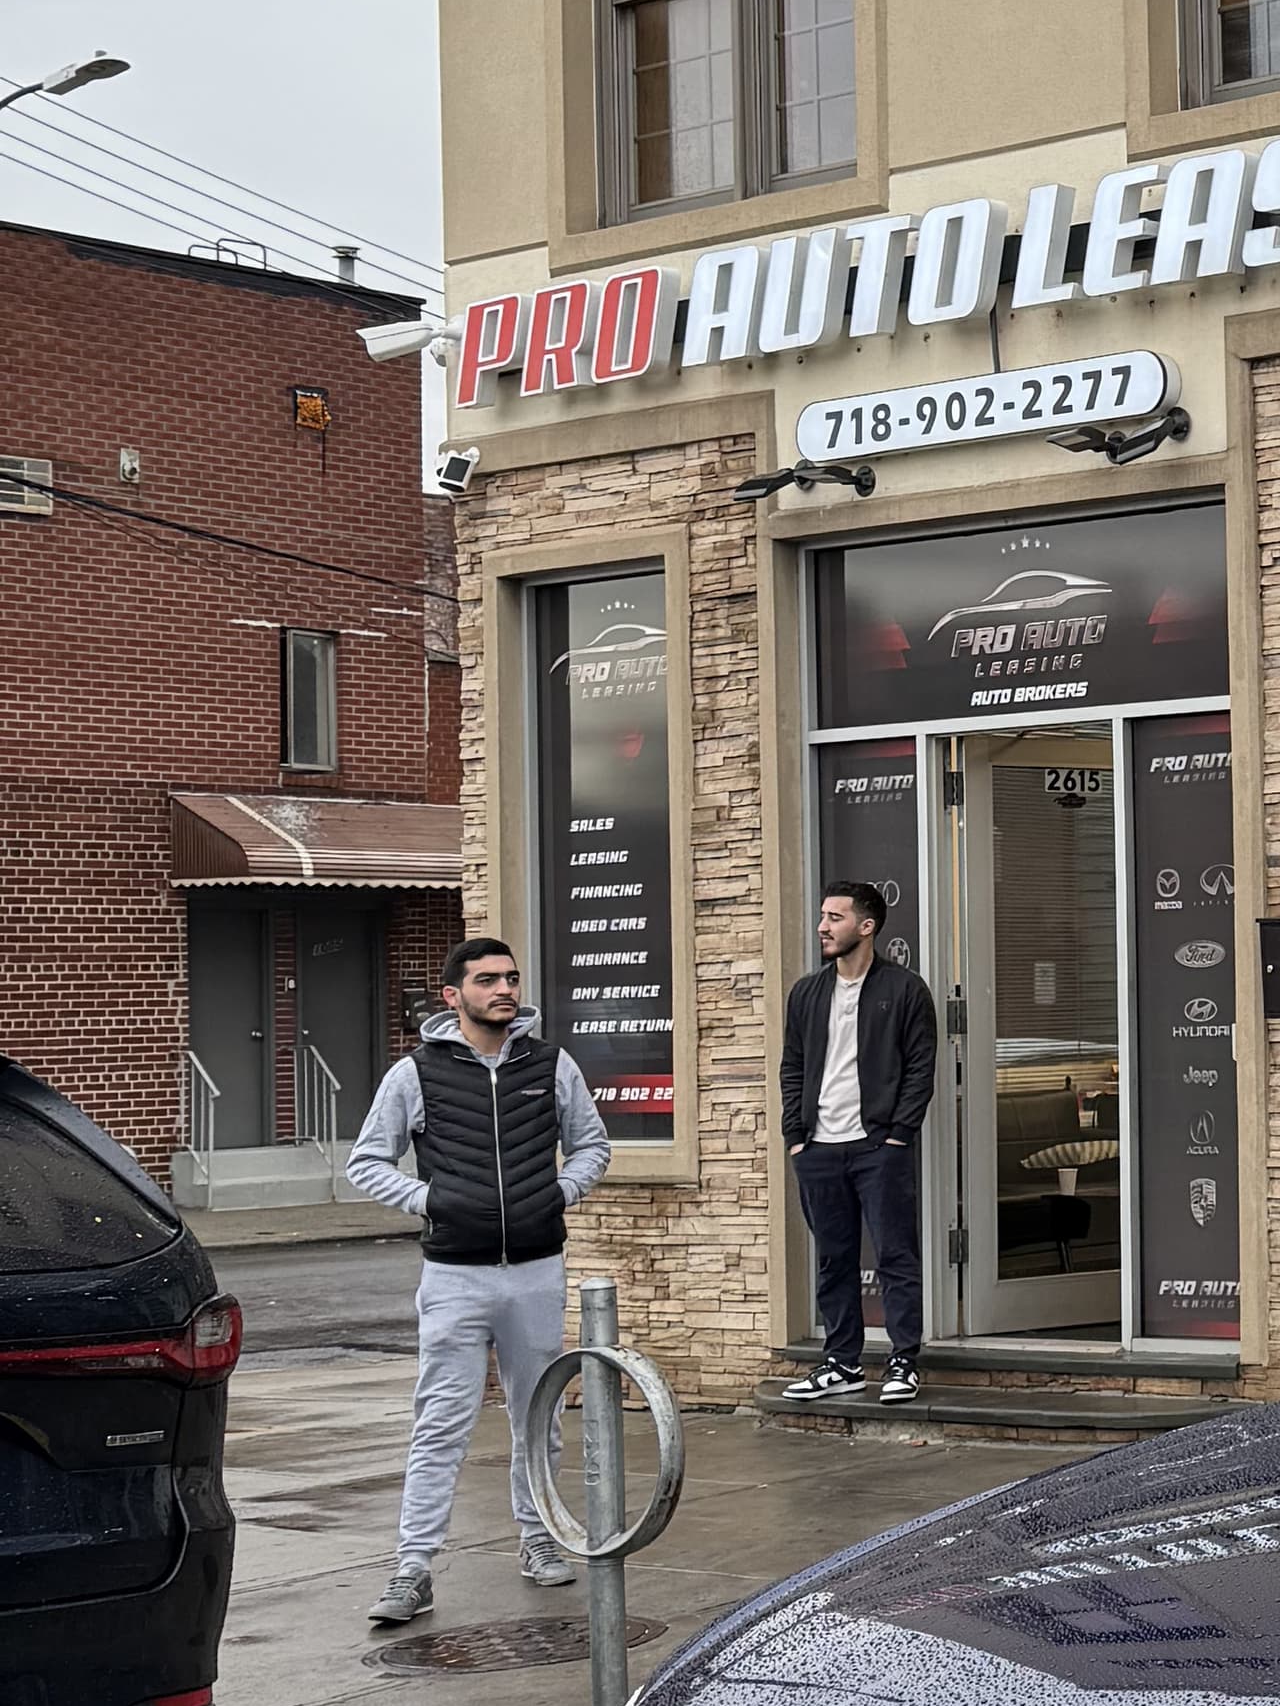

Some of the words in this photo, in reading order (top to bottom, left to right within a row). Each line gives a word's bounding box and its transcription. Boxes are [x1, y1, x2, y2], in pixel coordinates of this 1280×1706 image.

[455, 264, 680, 408] PRO
[681, 198, 1008, 368] AUTO
[824, 365, 1133, 450] 718-902-2277
[951, 620, 1017, 658] PRO
[1019, 614, 1109, 651] AUTO
[565, 661, 611, 685] PRO
[615, 655, 668, 680] AUTO
[974, 652, 1086, 678] LEASING
[581, 681, 657, 699] LEASING
[970, 688, 1011, 707] AUTO
[1014, 681, 1089, 704] BROKERS
[1149, 755, 1188, 773] PRO
[834, 778, 868, 794] PRO
[870, 774, 915, 791] AUTO
[1047, 770, 1101, 792] 2615
[569, 817, 615, 833] SALES
[570, 850, 629, 866] LEASING
[570, 883, 643, 900] FINANCING
[571, 919, 607, 933] USED
[609, 917, 647, 932] CARS
[571, 951, 648, 966] INSURANCE
[571, 987, 600, 1000] DMV
[602, 985, 661, 999] SERVICE
[572, 1020, 617, 1034] LEASE
[1172, 1026, 1231, 1038] HYUNDAI
[1183, 1066, 1219, 1087] Jeep
[593, 1088, 616, 1101] 718
[619, 1087, 649, 1101] 902
[1186, 1146, 1220, 1155] ACURA
[1158, 1280, 1196, 1296] PRO
